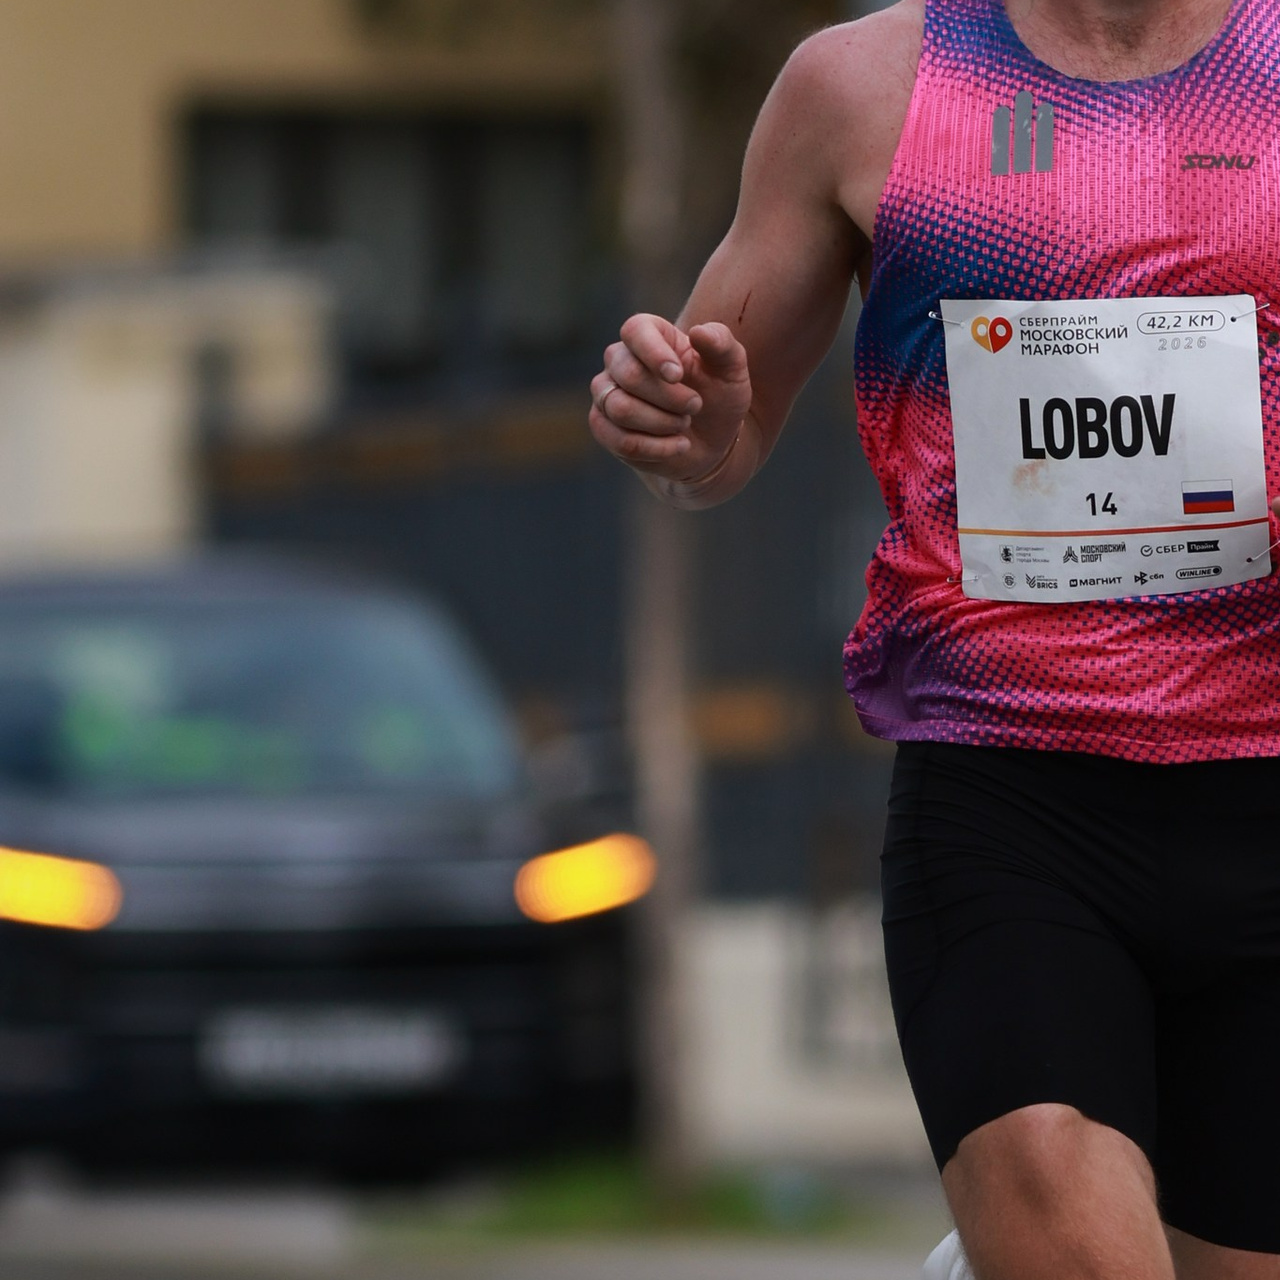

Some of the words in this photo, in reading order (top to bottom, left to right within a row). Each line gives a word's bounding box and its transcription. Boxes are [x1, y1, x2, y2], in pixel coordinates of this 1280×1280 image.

[1019, 315, 1098, 327] СБЕРПРАЙМ
[1146, 316, 1182, 330] 42,2
[1020, 325, 1128, 341] МОСКОВСКИЙ
[1021, 342, 1099, 355] МАРАФОН
[1158, 336, 1207, 351] 2026
[1019, 393, 1176, 460] LOBOV
[1086, 492, 1117, 516] 14
[1080, 541, 1126, 553] МОСКОВСКИЙ
[1156, 544, 1185, 554] СБЕР
[1081, 553, 1102, 563] СПОРТ
[1179, 569, 1212, 578] WINLINE
[1036, 581, 1058, 589] BRICS
